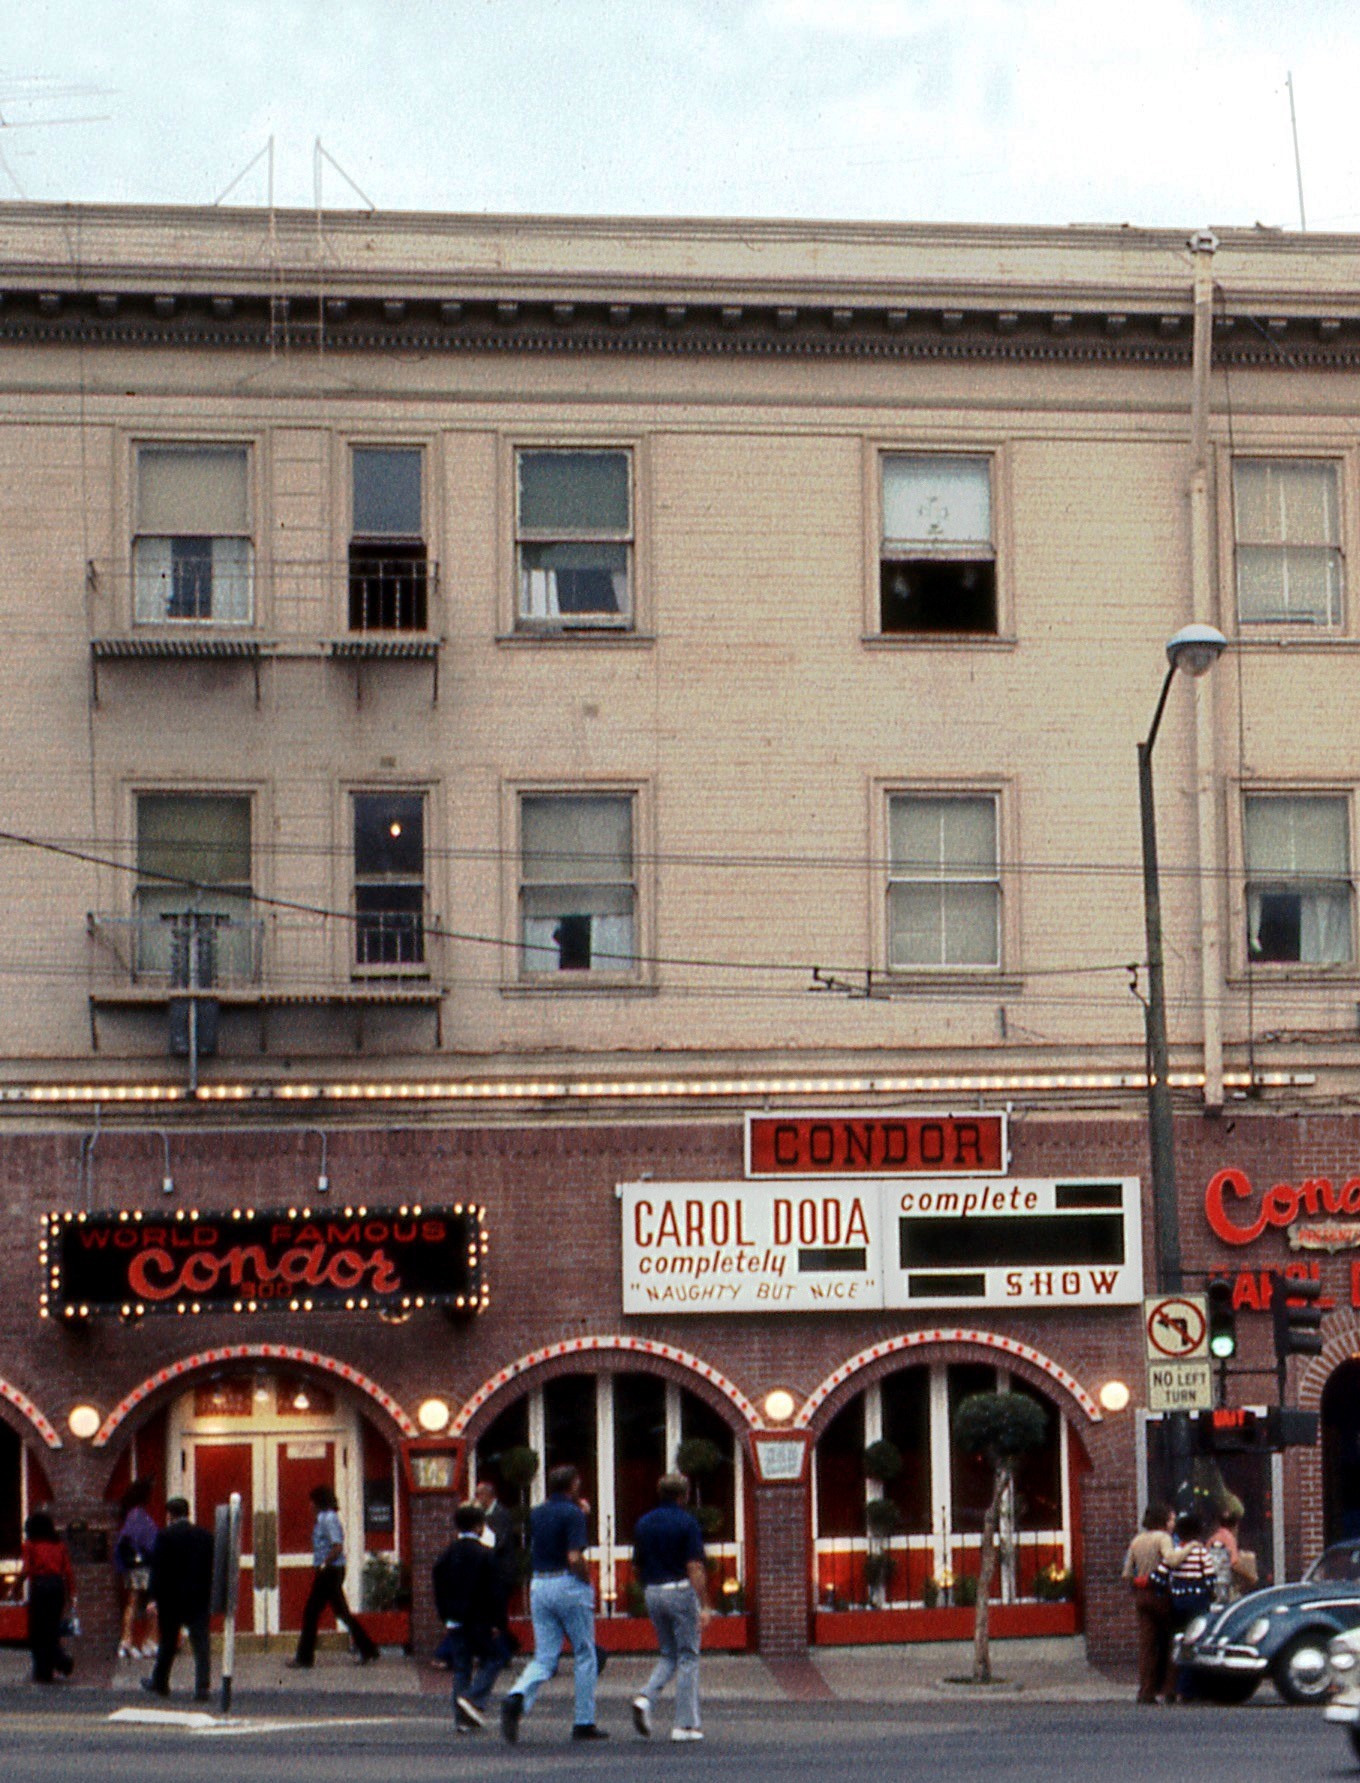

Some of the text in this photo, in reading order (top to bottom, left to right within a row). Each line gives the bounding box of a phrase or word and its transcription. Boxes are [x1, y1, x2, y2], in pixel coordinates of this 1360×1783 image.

[774, 1122, 983, 1167] CONDOR
[901, 1187, 1037, 1217] complete
[80, 1221, 447, 1249] WORLD FAMOUS
[634, 1197, 870, 1248] CAROL DODA
[128, 1243, 400, 1300] Condor
[639, 1249, 786, 1280] completely
[757, 1284, 796, 1300] BUT
[1007, 1270, 1120, 1297] SHOW
[1153, 1372, 1206, 1387] NO LEFT
[1166, 1389, 1197, 1403] TURN
